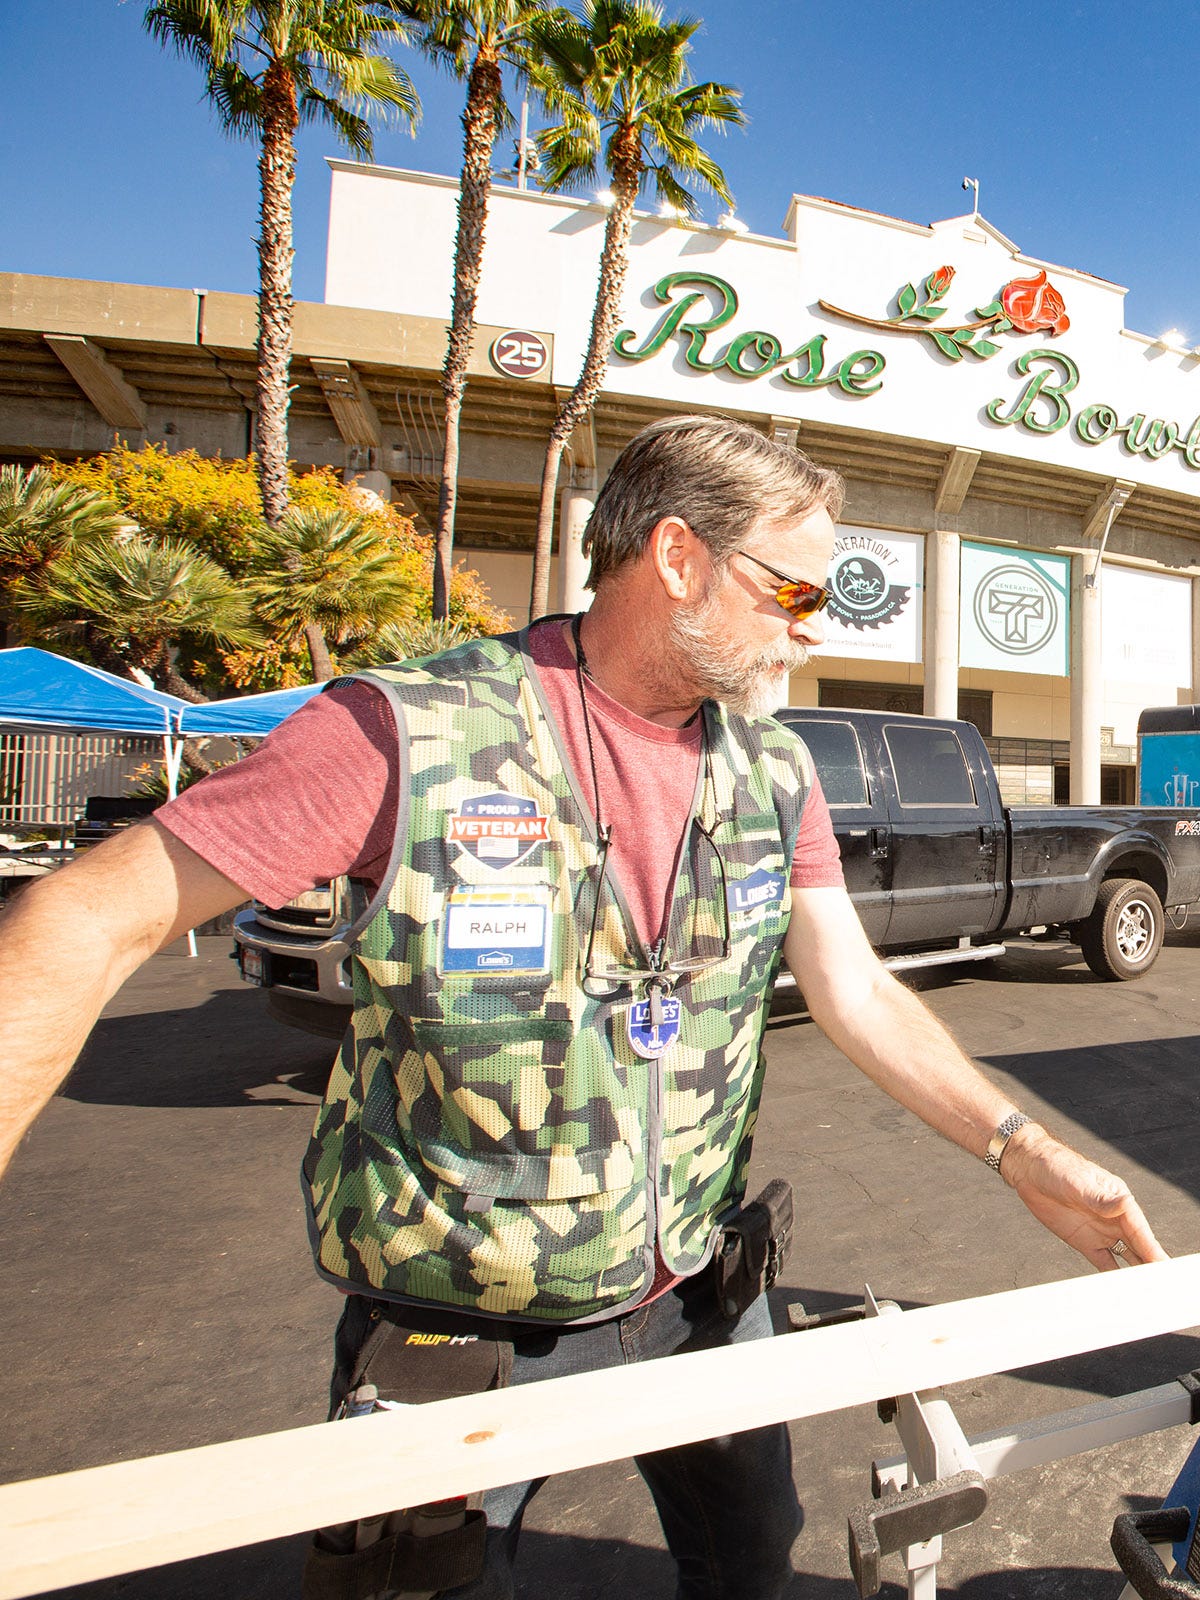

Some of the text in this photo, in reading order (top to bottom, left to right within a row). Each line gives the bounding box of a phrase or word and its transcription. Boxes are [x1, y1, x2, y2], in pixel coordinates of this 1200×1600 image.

[614, 272, 886, 396] Rose
[500, 338, 543, 368] 25
[995, 582, 1039, 592] GENERATION
[836, 606, 853, 619] BOWL
[477, 804, 520, 815] PROUD
[454, 820, 543, 836] VETERAN
[470, 922, 526, 934] RALPH
[404, 1334, 451, 1347] AWP
